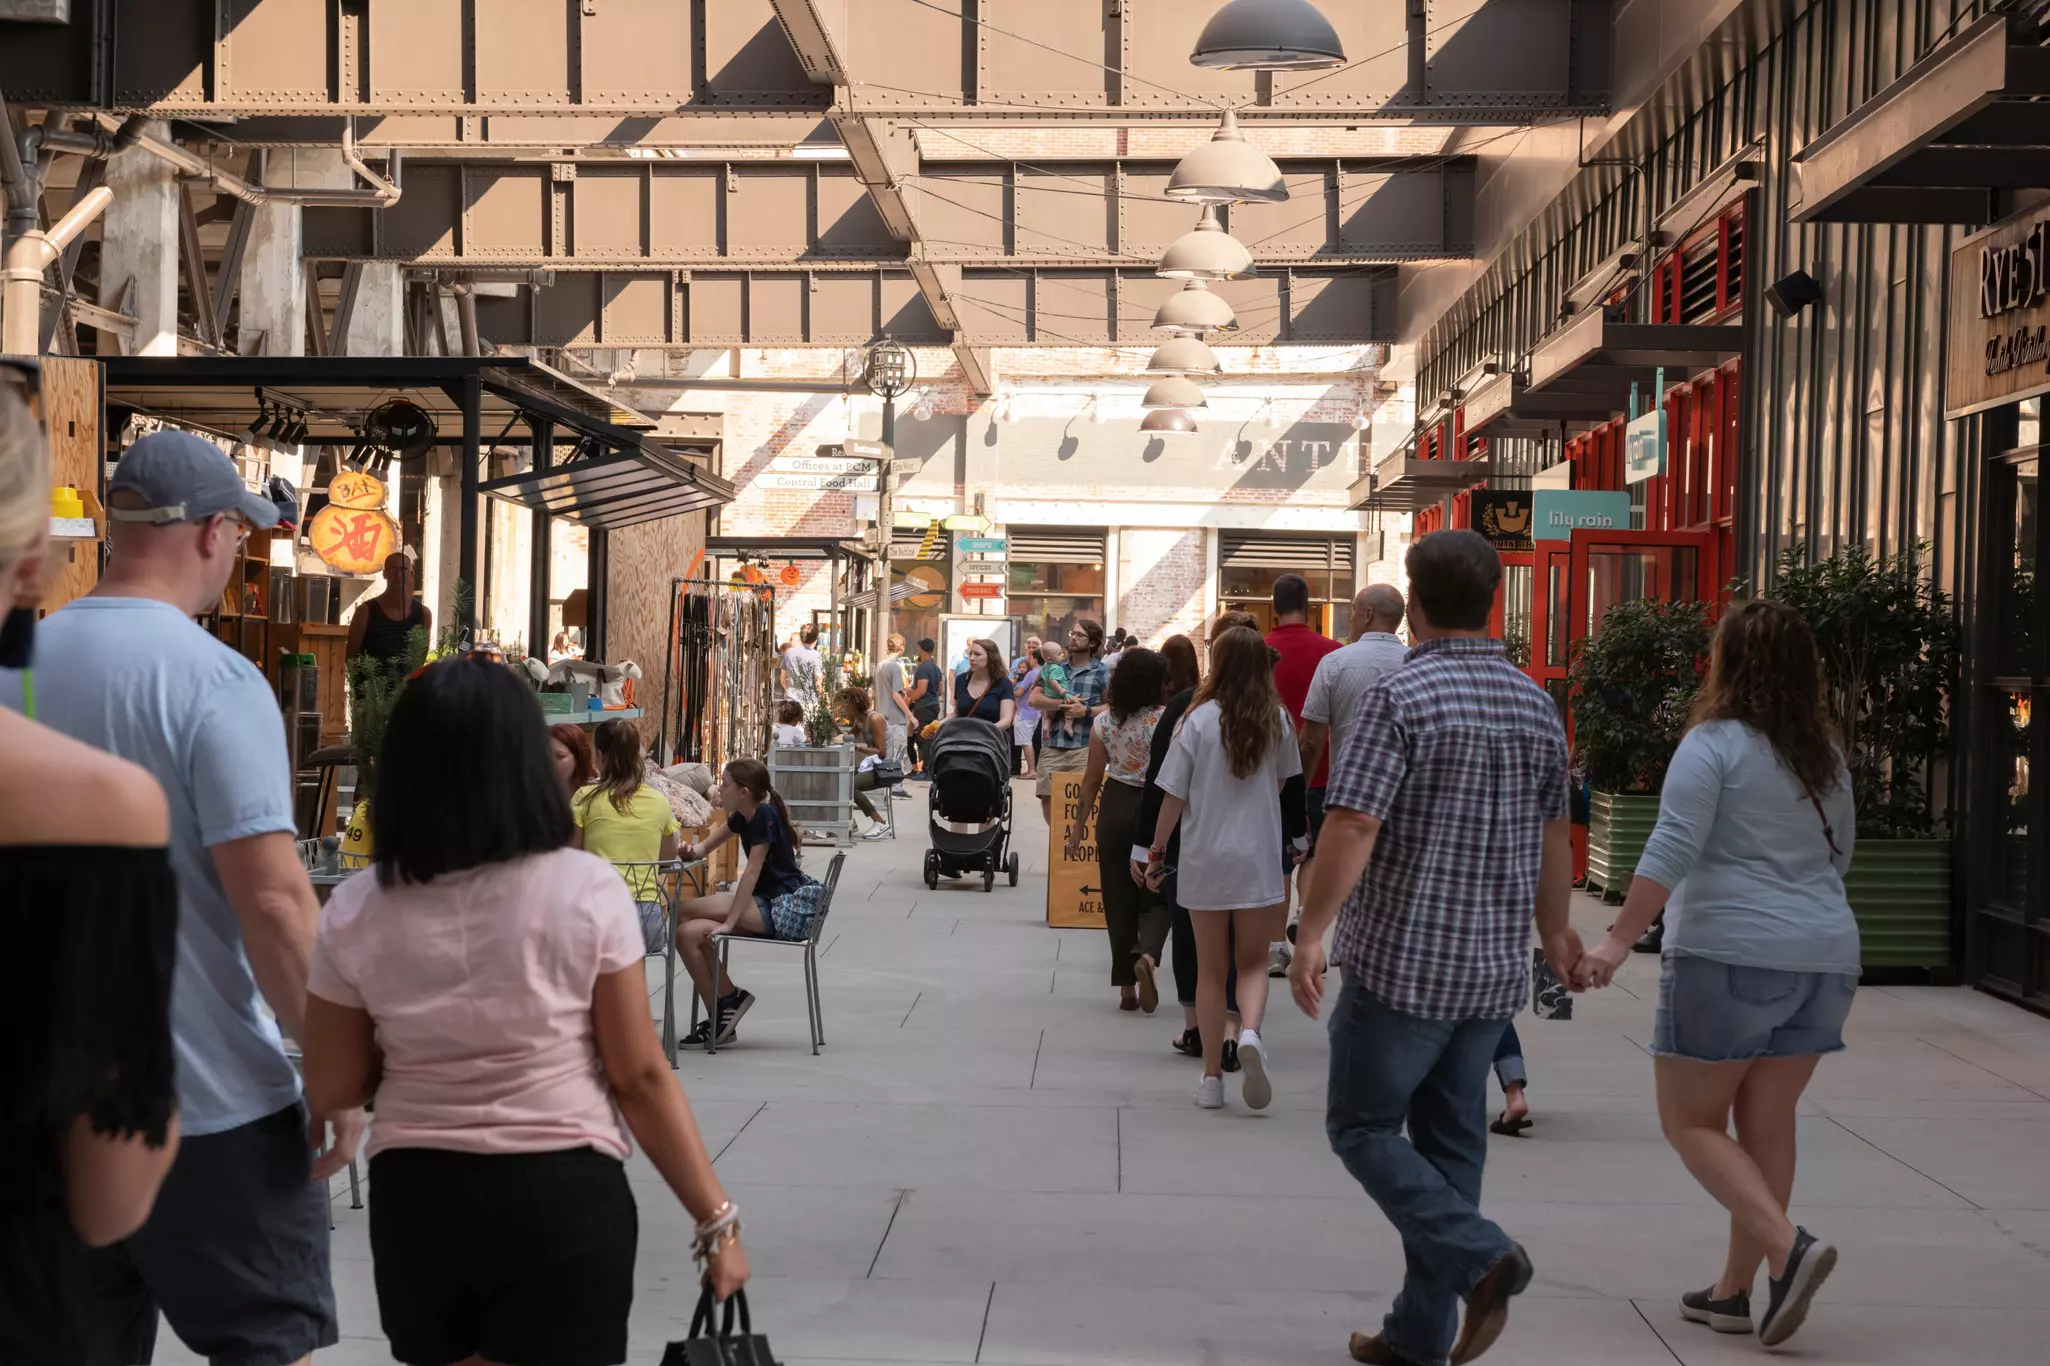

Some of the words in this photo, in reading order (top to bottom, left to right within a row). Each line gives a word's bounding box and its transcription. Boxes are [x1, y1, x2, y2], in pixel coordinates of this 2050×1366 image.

[792, 460, 829, 469] Offices
[832, 462, 844, 470] at
[846, 462, 871, 471] PCM
[337, 476, 381, 498] BAR
[777, 477, 817, 487] Central
[821, 478, 845, 487] Food
[848, 478, 870, 488] Hall
[1549, 511, 1574, 528] lily
[1578, 512, 1613, 528] rain
[322, 513, 382, 562] 酒
[1064, 825, 1089, 841] AD
[1079, 901, 1095, 913] ACE
